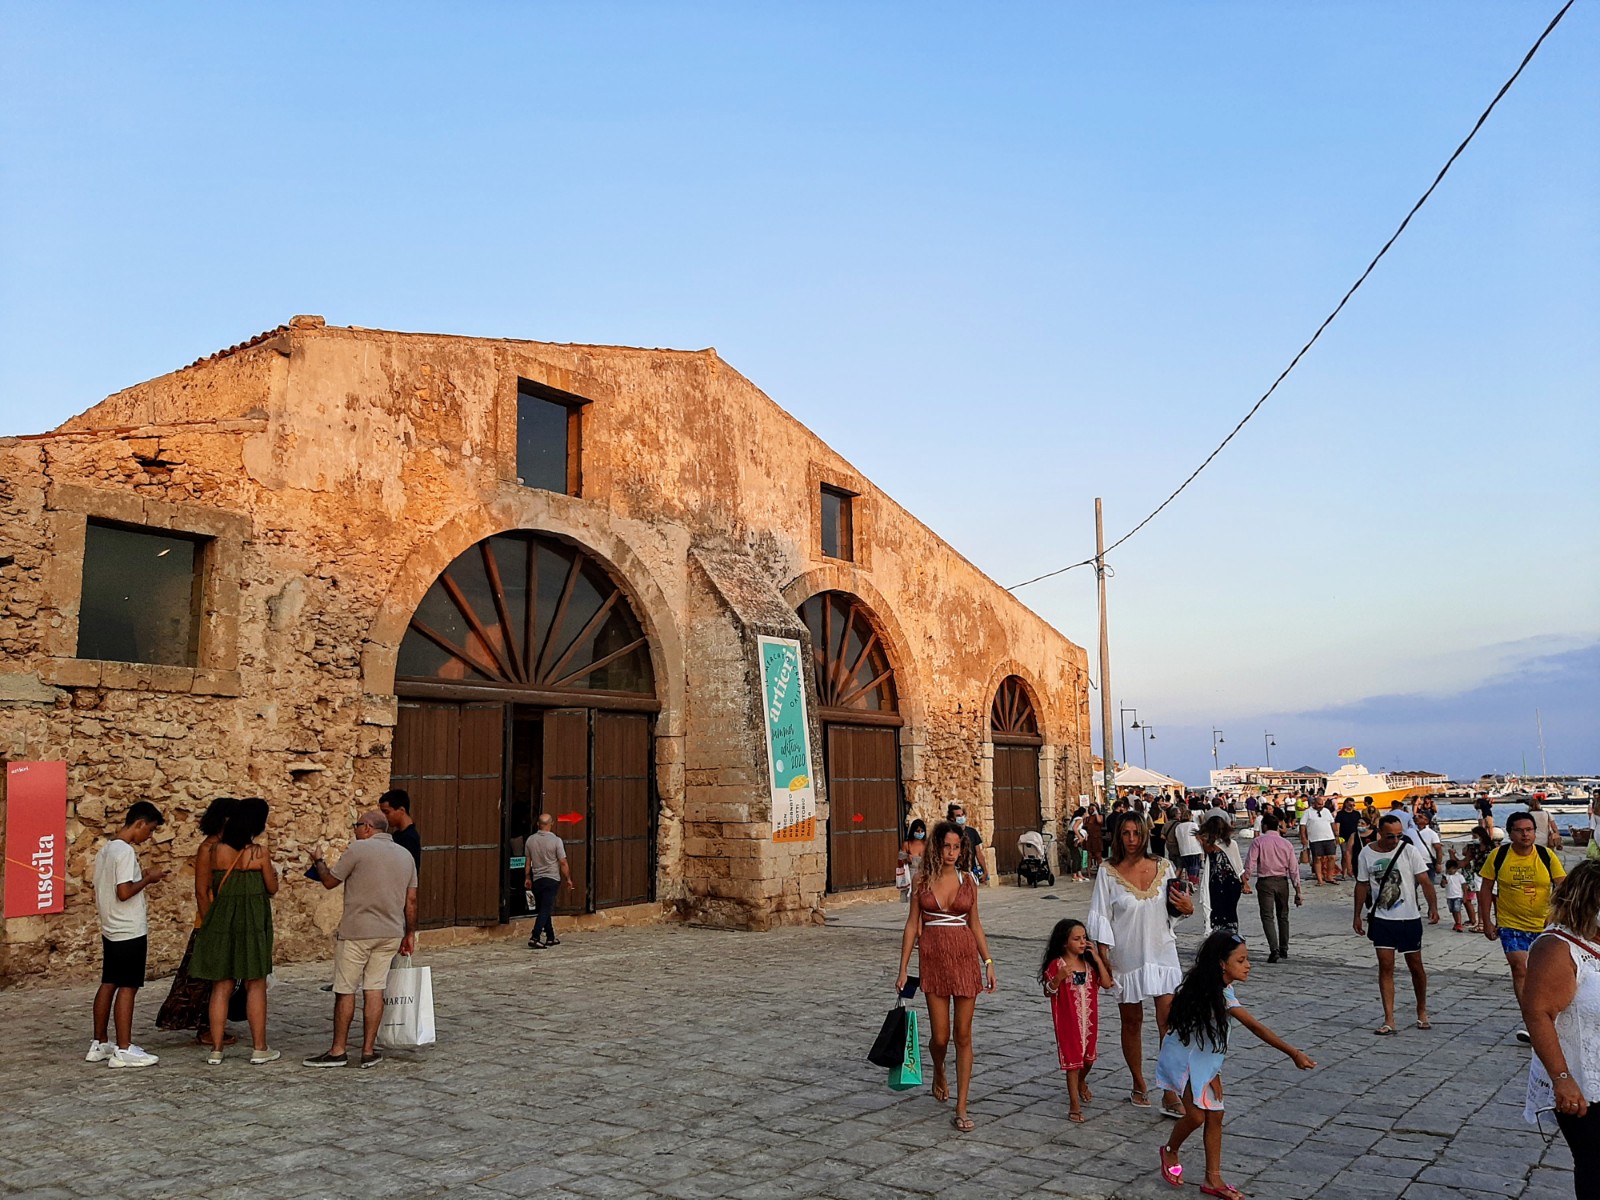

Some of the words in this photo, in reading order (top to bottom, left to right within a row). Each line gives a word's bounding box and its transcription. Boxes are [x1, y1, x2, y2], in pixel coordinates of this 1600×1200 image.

[769, 647, 796, 723] artieri
[791, 754, 806, 769] 2020
[32, 833, 55, 910] uscita
[383, 996, 414, 1006] MARTIN
